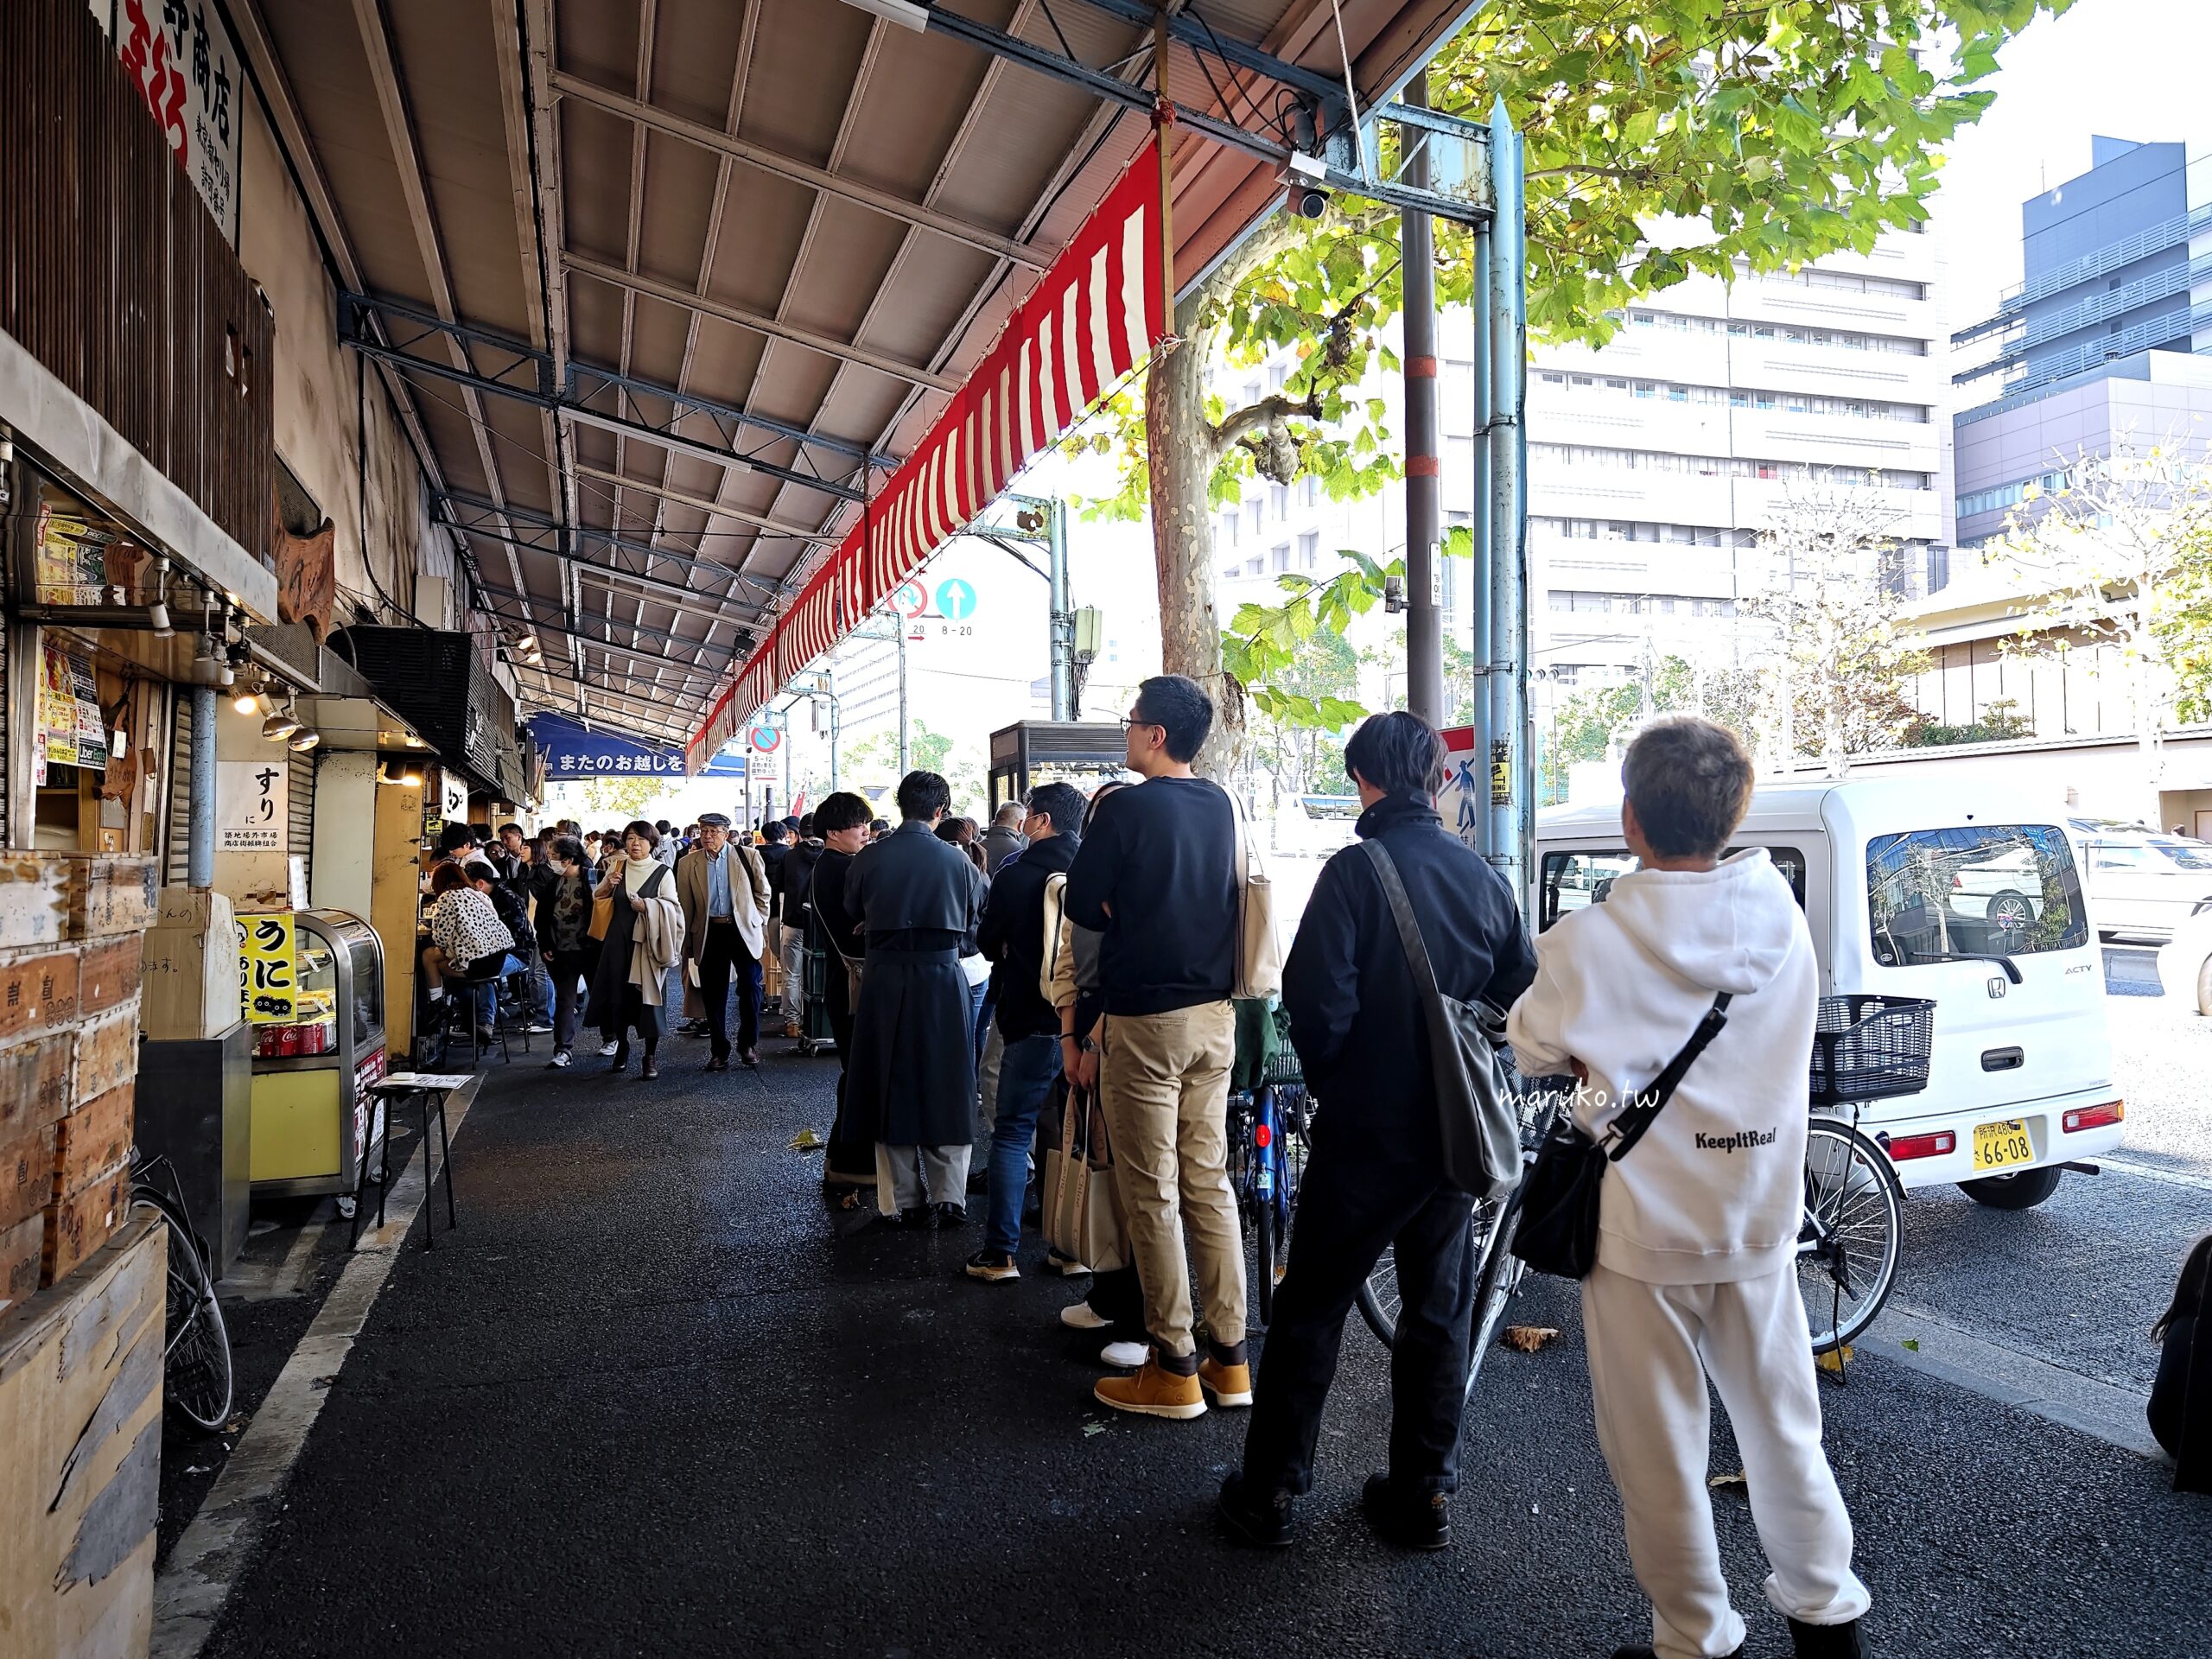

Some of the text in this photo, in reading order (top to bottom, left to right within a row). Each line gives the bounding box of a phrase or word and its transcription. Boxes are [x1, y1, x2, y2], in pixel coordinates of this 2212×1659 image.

[79, 745, 93, 759] Uber
[560, 754, 684, 772] またのお越しを
[255, 767, 280, 822] すり
[245, 816, 256, 824] に
[255, 919, 291, 989] うに
[2065, 964, 2092, 975] ACTY
[1694, 1126, 1777, 1154] KeepItReal
[1978, 1126, 1998, 1140] 所沢
[1984, 1136, 2029, 1165] 66-08
